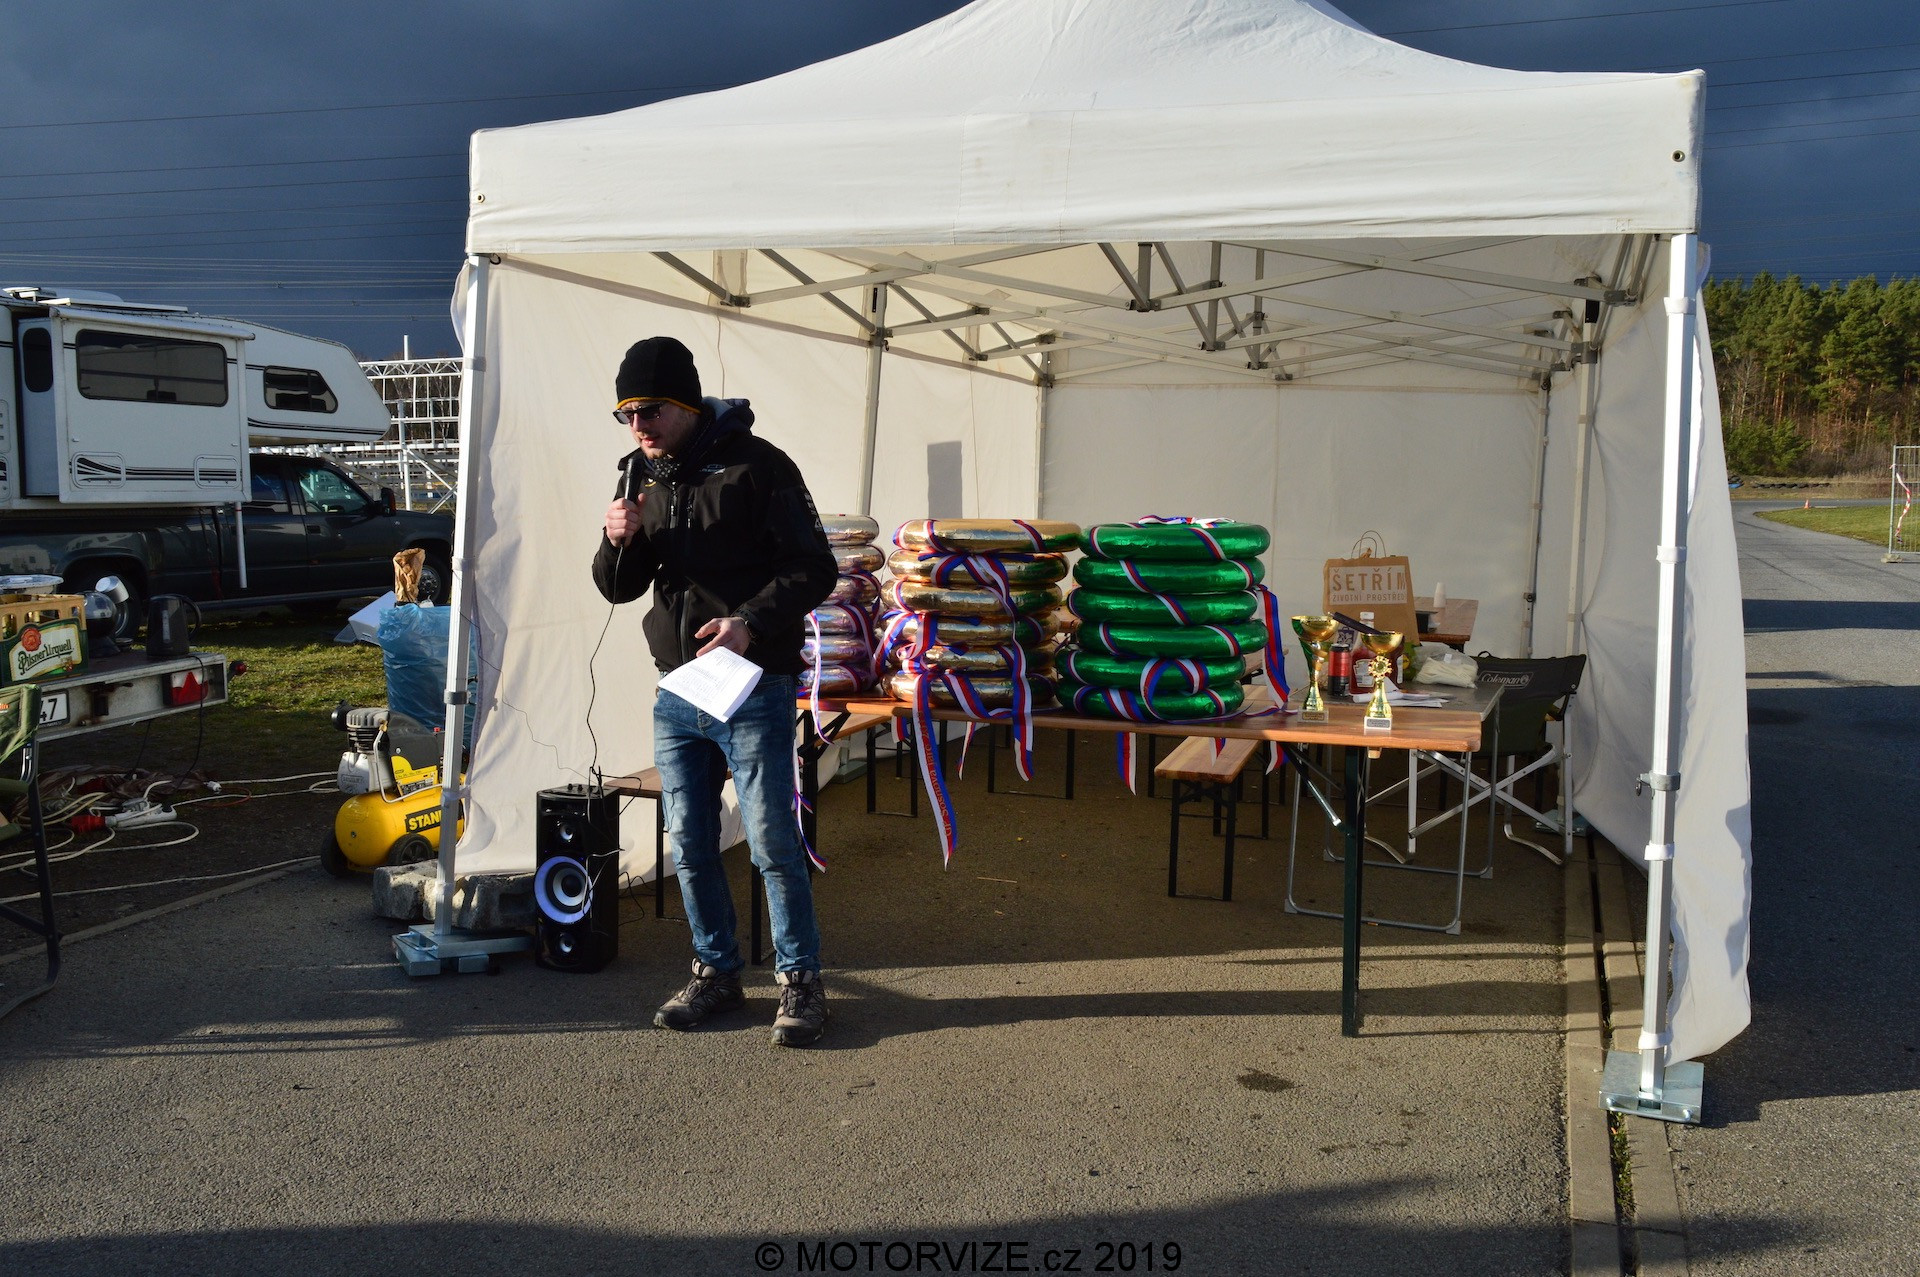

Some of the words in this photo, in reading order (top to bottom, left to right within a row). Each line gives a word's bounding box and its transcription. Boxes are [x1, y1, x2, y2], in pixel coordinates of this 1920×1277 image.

[18, 650, 45, 675] Pilsner
[44, 639, 72, 658] Urquell
[1481, 673, 1521, 684] Coleman
[408, 809, 442, 831] STAN
